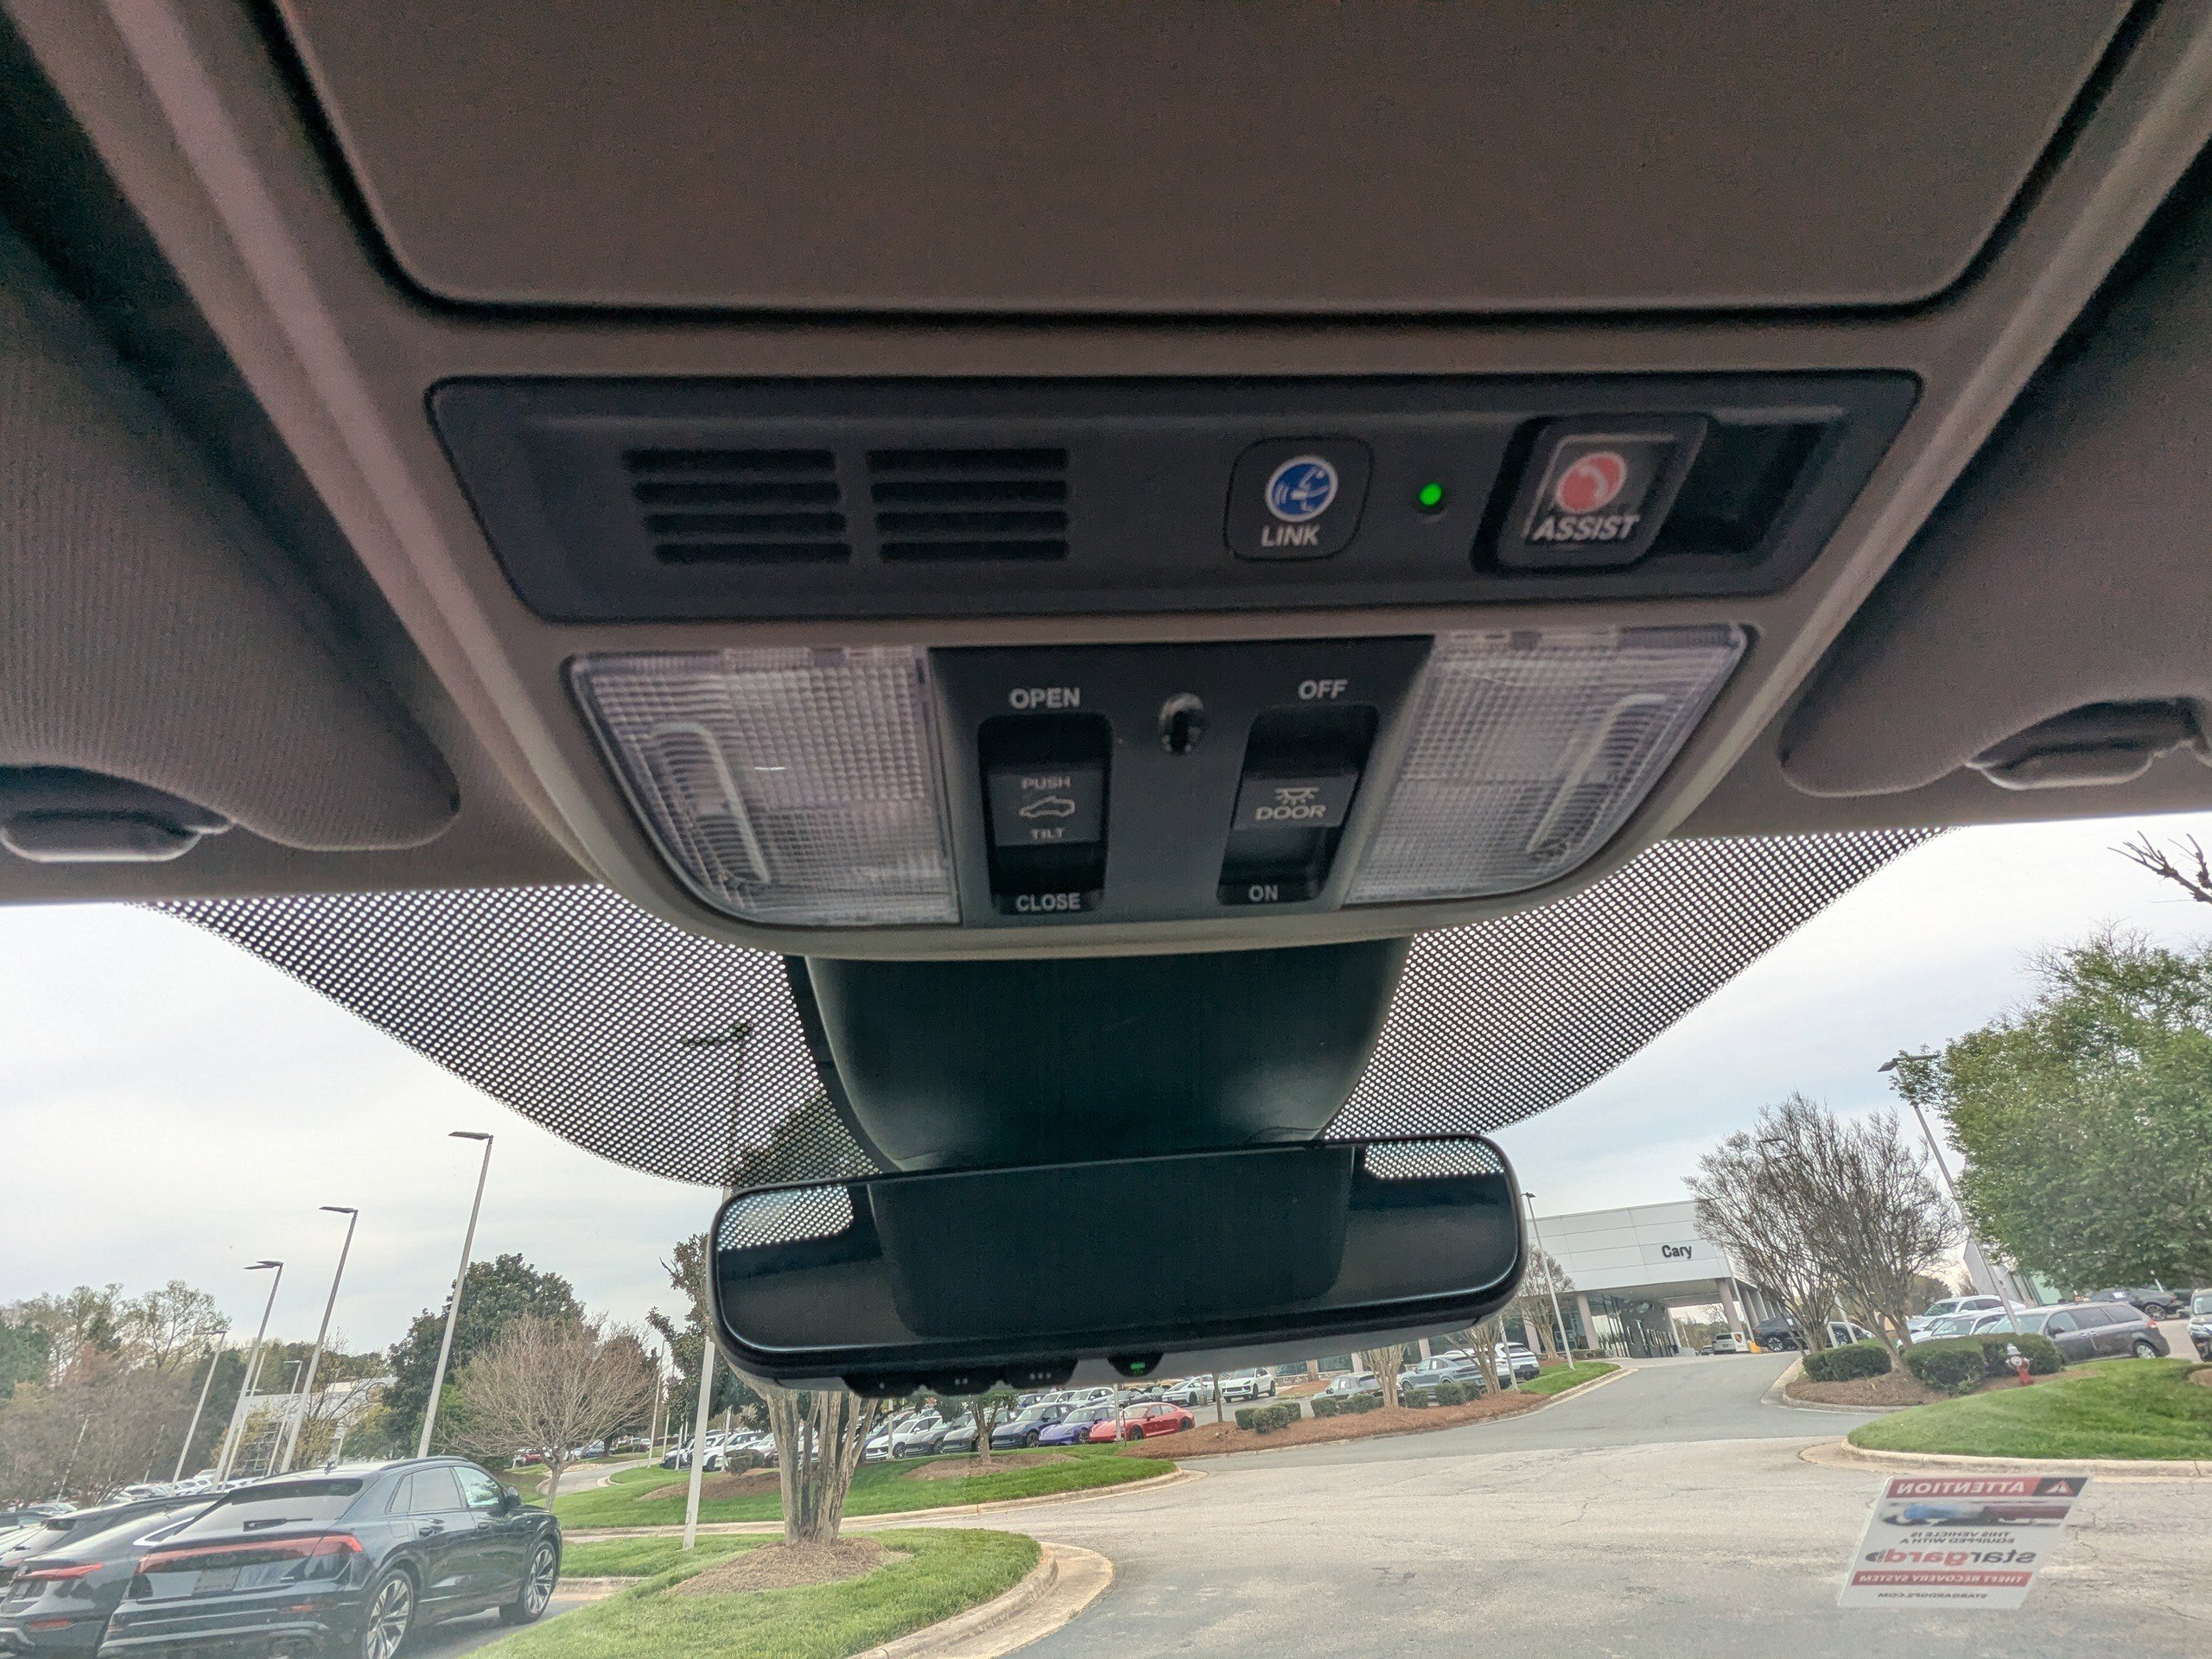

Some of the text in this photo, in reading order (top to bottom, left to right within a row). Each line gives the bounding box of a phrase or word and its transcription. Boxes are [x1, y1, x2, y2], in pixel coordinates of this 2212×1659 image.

[1262, 524, 1320, 548] LINK
[1533, 514, 1640, 543] ASSIST
[1007, 687, 1081, 709] OPEN
[1297, 678, 1349, 701] OFF
[1020, 776, 1071, 790] PUSH
[1255, 804, 1327, 822] DOOR
[1031, 827, 1066, 841] TILT
[1015, 891, 1082, 912] CLOSE
[1248, 883, 1280, 903] ON
[1662, 1244, 1692, 1259] Cary
